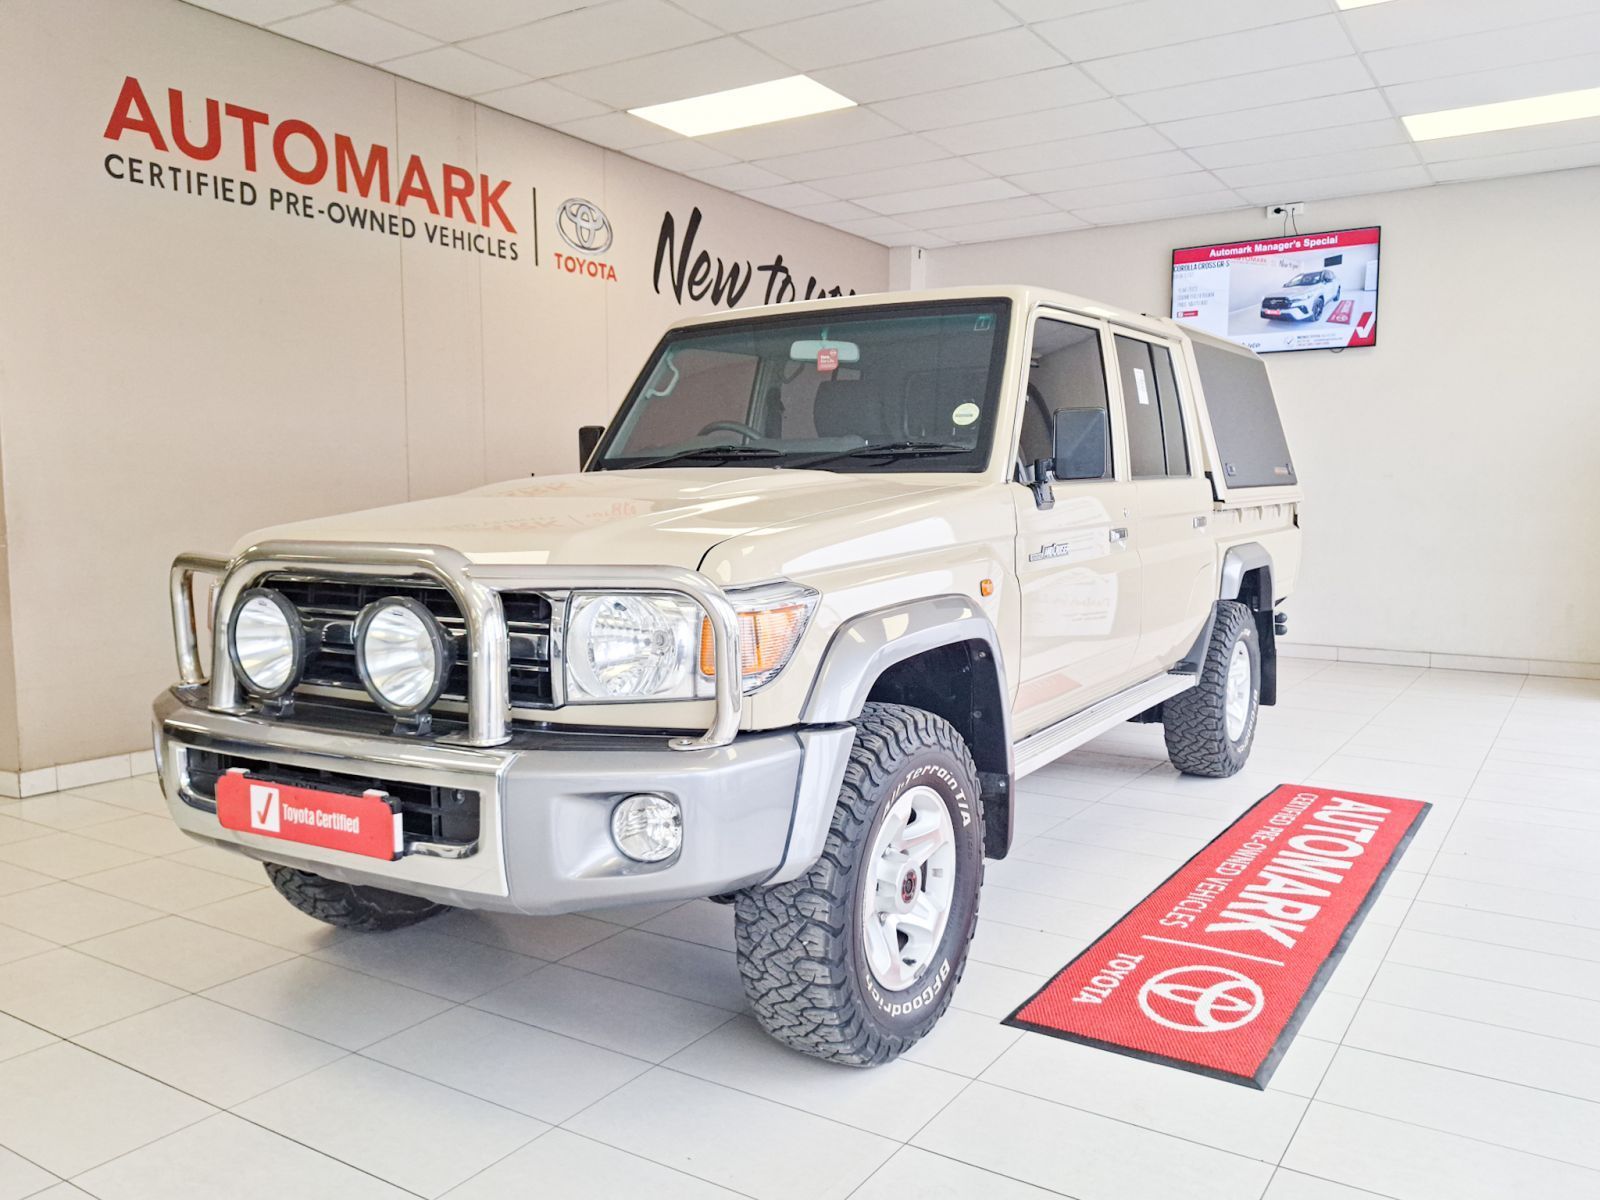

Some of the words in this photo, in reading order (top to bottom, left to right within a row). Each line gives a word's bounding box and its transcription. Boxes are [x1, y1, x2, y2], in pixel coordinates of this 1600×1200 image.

[103, 76, 518, 234] AUTOMARK
[104, 154, 257, 206] CERTIFIED
[269, 188, 416, 239] PRE-OWNED
[424, 222, 519, 261] VEHICLES
[554, 252, 617, 282] TOYOTA
[653, 206, 752, 308] New
[757, 254, 796, 305] to
[1209, 245, 1252, 258] Automark
[1254, 240, 1301, 253] Manager's
[1303, 235, 1338, 248] Special
[282, 803, 315, 825] Toyota
[315, 809, 360, 834] Certified
[955, 788, 971, 827] T/A
[1268, 792, 1319, 826] CERTIFIED
[1204, 796, 1391, 949] AUTOMARK
[1215, 825, 1285, 876] PRE-OWNED
[1158, 877, 1233, 929] VEHICLES
[866, 958, 950, 1018] BFGoodrich
[1072, 952, 1144, 1005] TOYOTA
